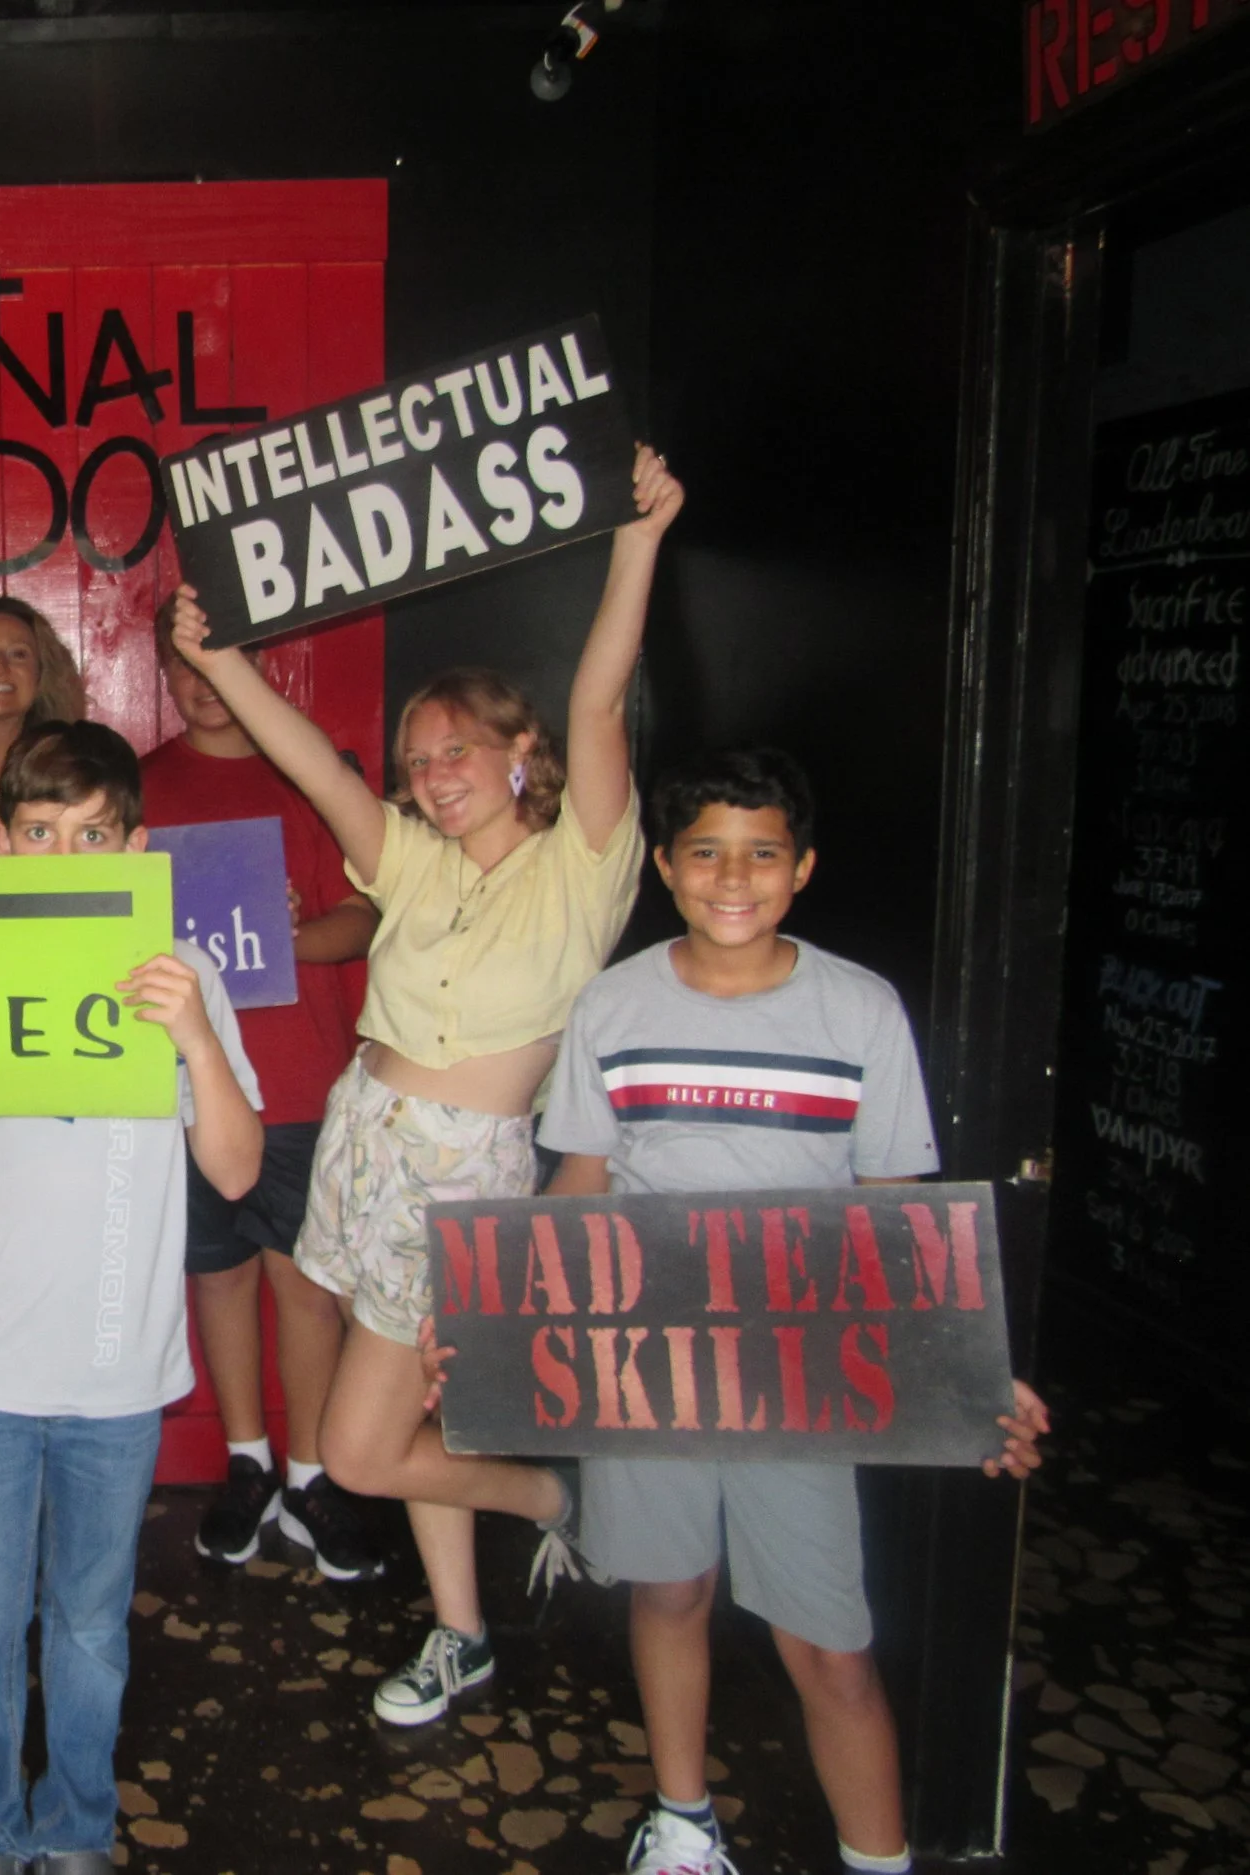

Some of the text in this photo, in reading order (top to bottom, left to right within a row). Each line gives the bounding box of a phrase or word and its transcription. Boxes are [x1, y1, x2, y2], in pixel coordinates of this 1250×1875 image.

[171, 333, 610, 528] INTELLECTUAL
[231, 425, 584, 625] BADASS
[667, 1087, 776, 1108] HILFIGER
[93, 1163, 133, 1368] ARMOUR
[435, 1202, 984, 1315] MAD TEAM
[531, 1323, 895, 1433] SKILLS
